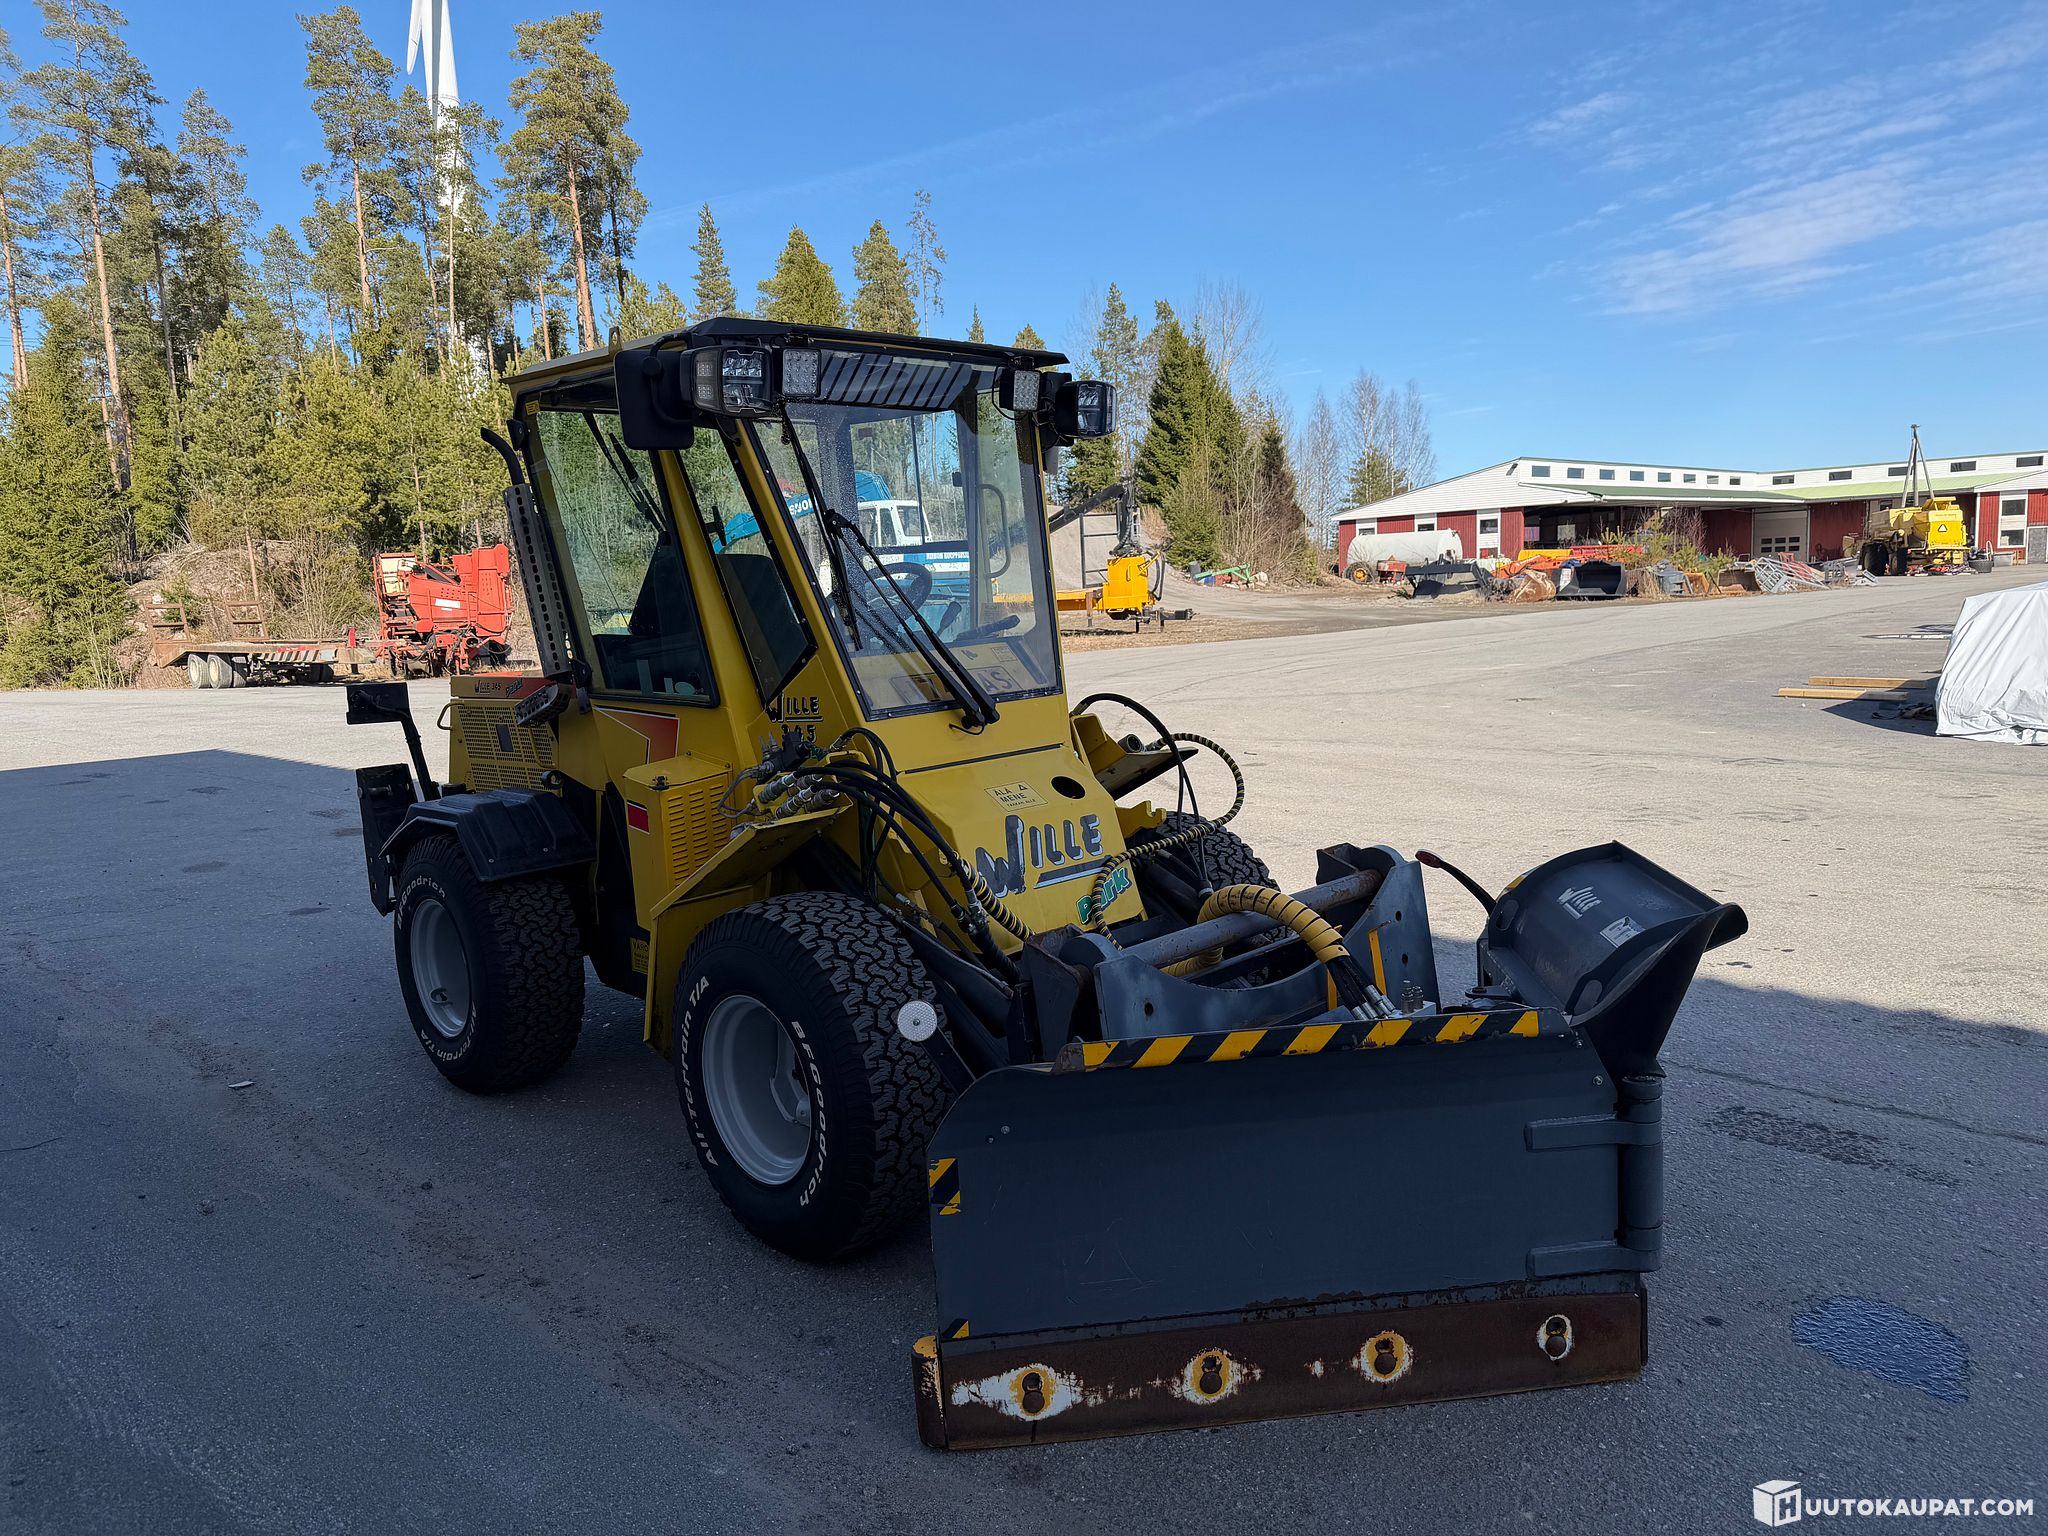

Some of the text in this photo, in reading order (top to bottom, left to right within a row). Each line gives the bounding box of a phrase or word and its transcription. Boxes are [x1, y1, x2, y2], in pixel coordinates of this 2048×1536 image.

[766, 691, 819, 723] WILLE
[1000, 792, 1027, 803] MENE
[976, 814, 1103, 897] WILLE
[688, 975, 710, 1007] T/A
[680, 1010, 719, 1167] All-Terrain
[791, 1021, 828, 1207] BFGoodrich
